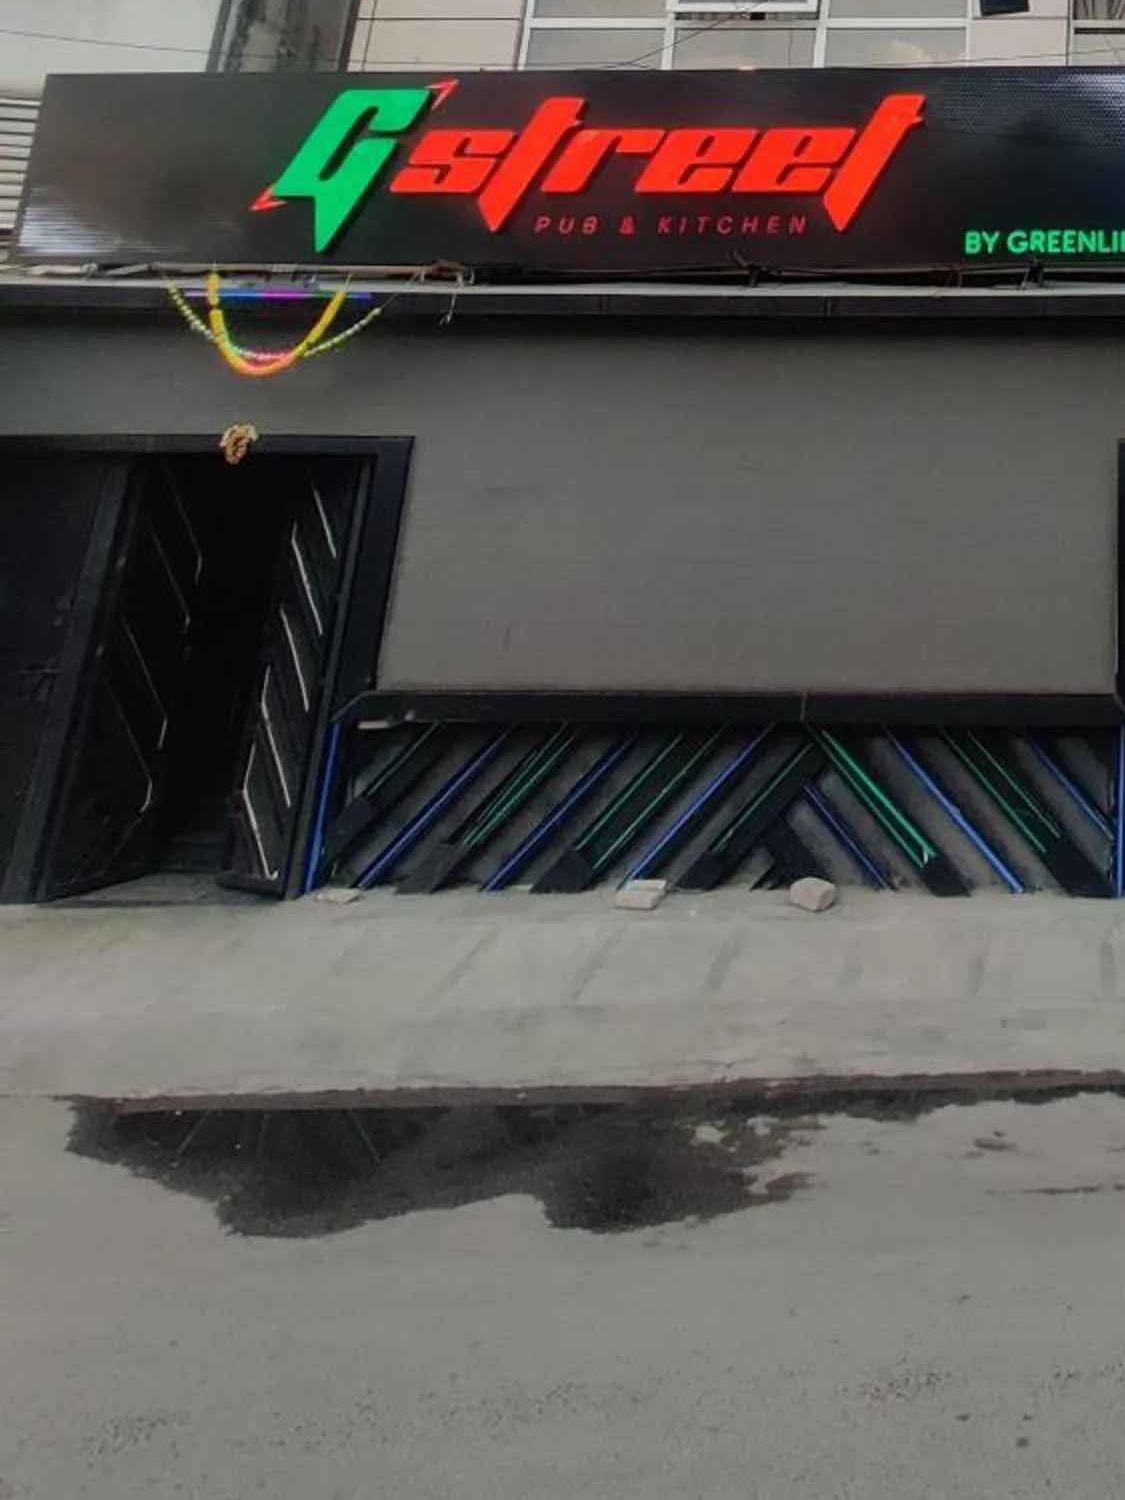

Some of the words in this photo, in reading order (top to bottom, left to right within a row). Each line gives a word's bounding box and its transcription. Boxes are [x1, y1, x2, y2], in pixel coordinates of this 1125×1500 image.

[534, 215, 600, 234] PUB
[619, 215, 636, 235] &
[656, 215, 807, 234] KITCHEN
[964, 231, 1000, 254] BY
